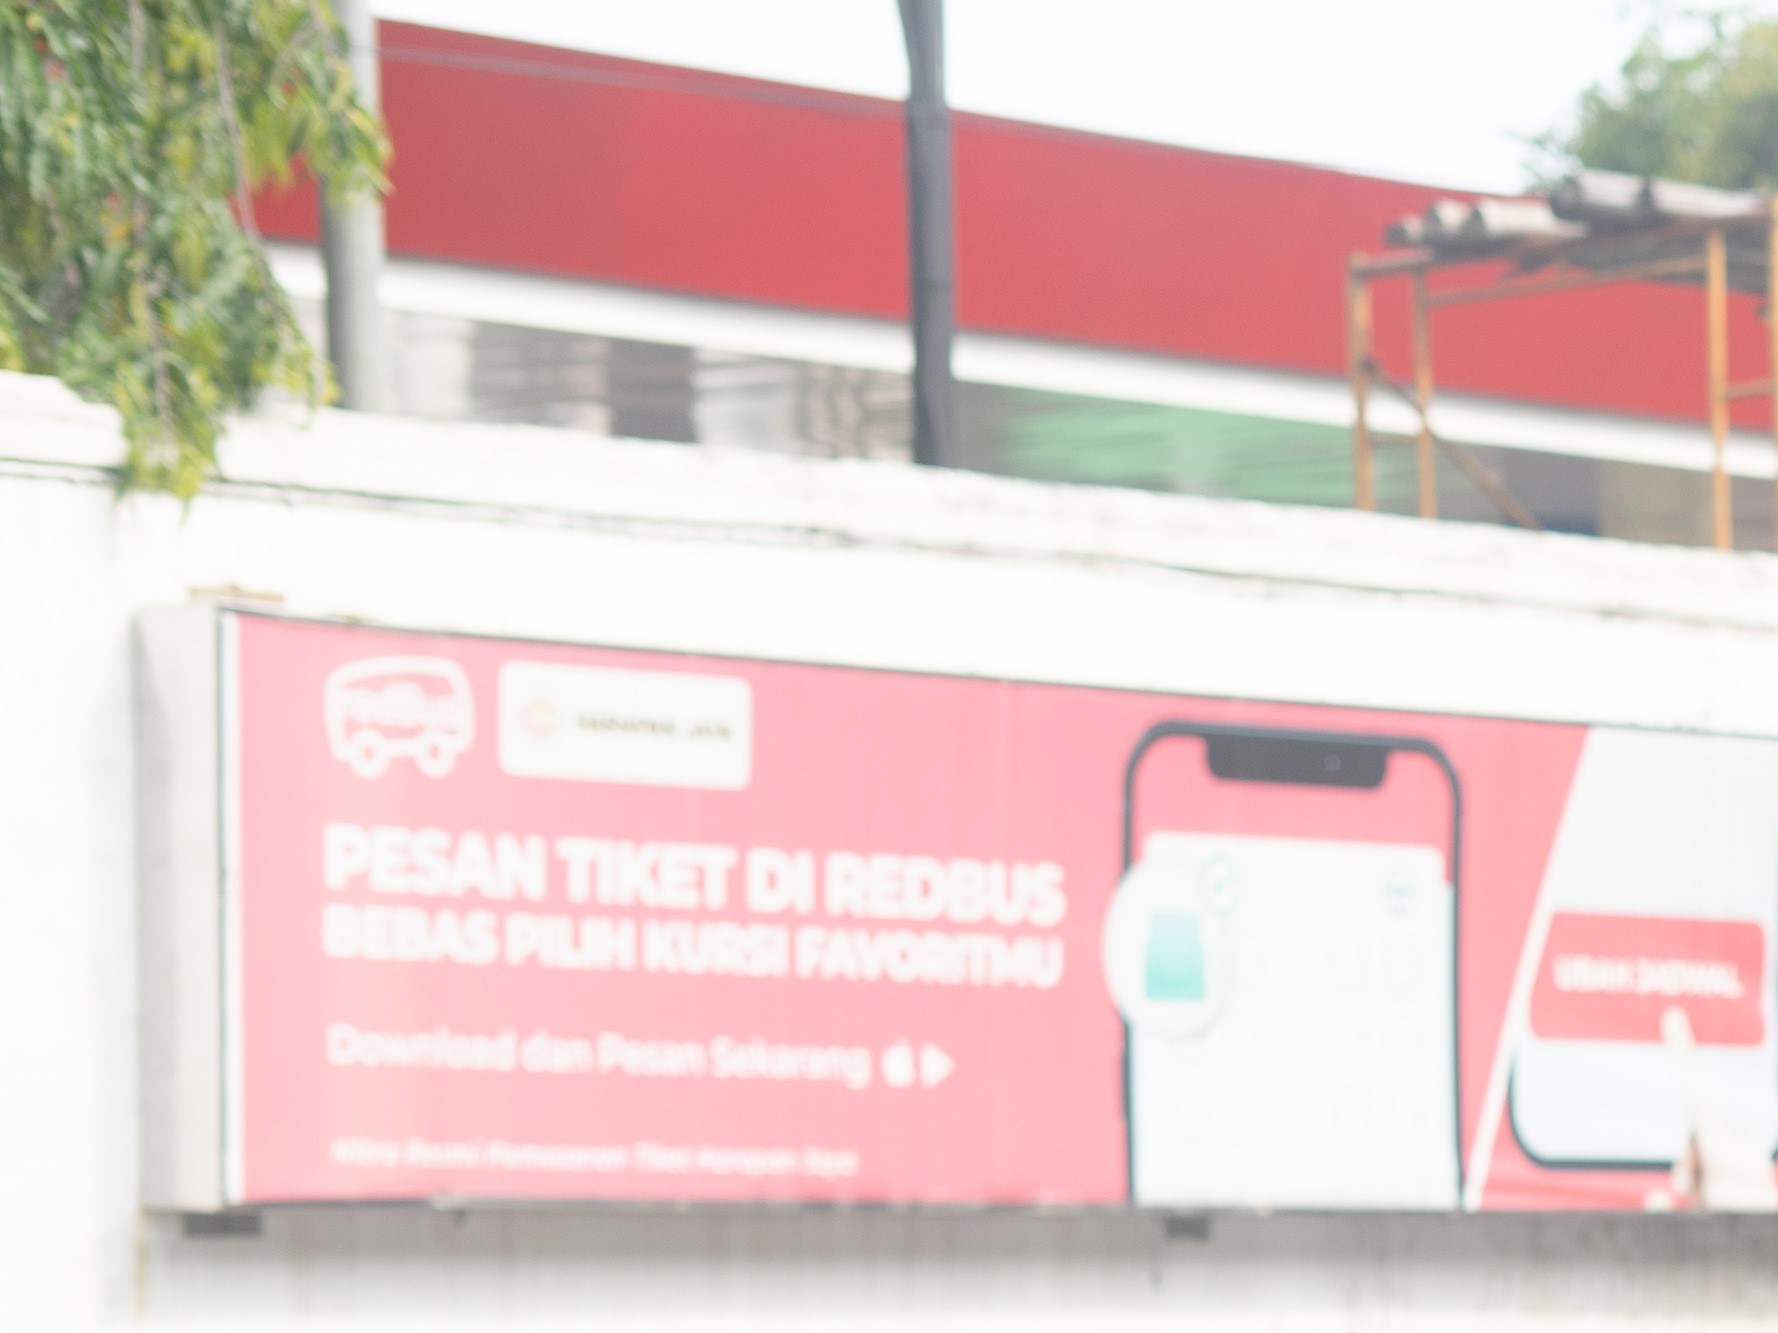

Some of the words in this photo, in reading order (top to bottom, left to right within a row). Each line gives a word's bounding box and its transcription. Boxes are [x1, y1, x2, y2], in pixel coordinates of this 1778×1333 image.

[323, 822, 547, 902] PESAN
[554, 835, 739, 911] TIKET
[746, 846, 815, 915] DI
[824, 851, 1067, 927] REDBUS
[322, 902, 498, 965] BEBAS
[505, 910, 636, 971] PILIH
[642, 916, 790, 978] KURSI
[795, 924, 1064, 990] FAVORITMU
[326, 1021, 517, 1072] Download
[521, 1027, 594, 1074] dan
[595, 1031, 707, 1078] Pesan
[708, 1034, 872, 1091] Sekarang
